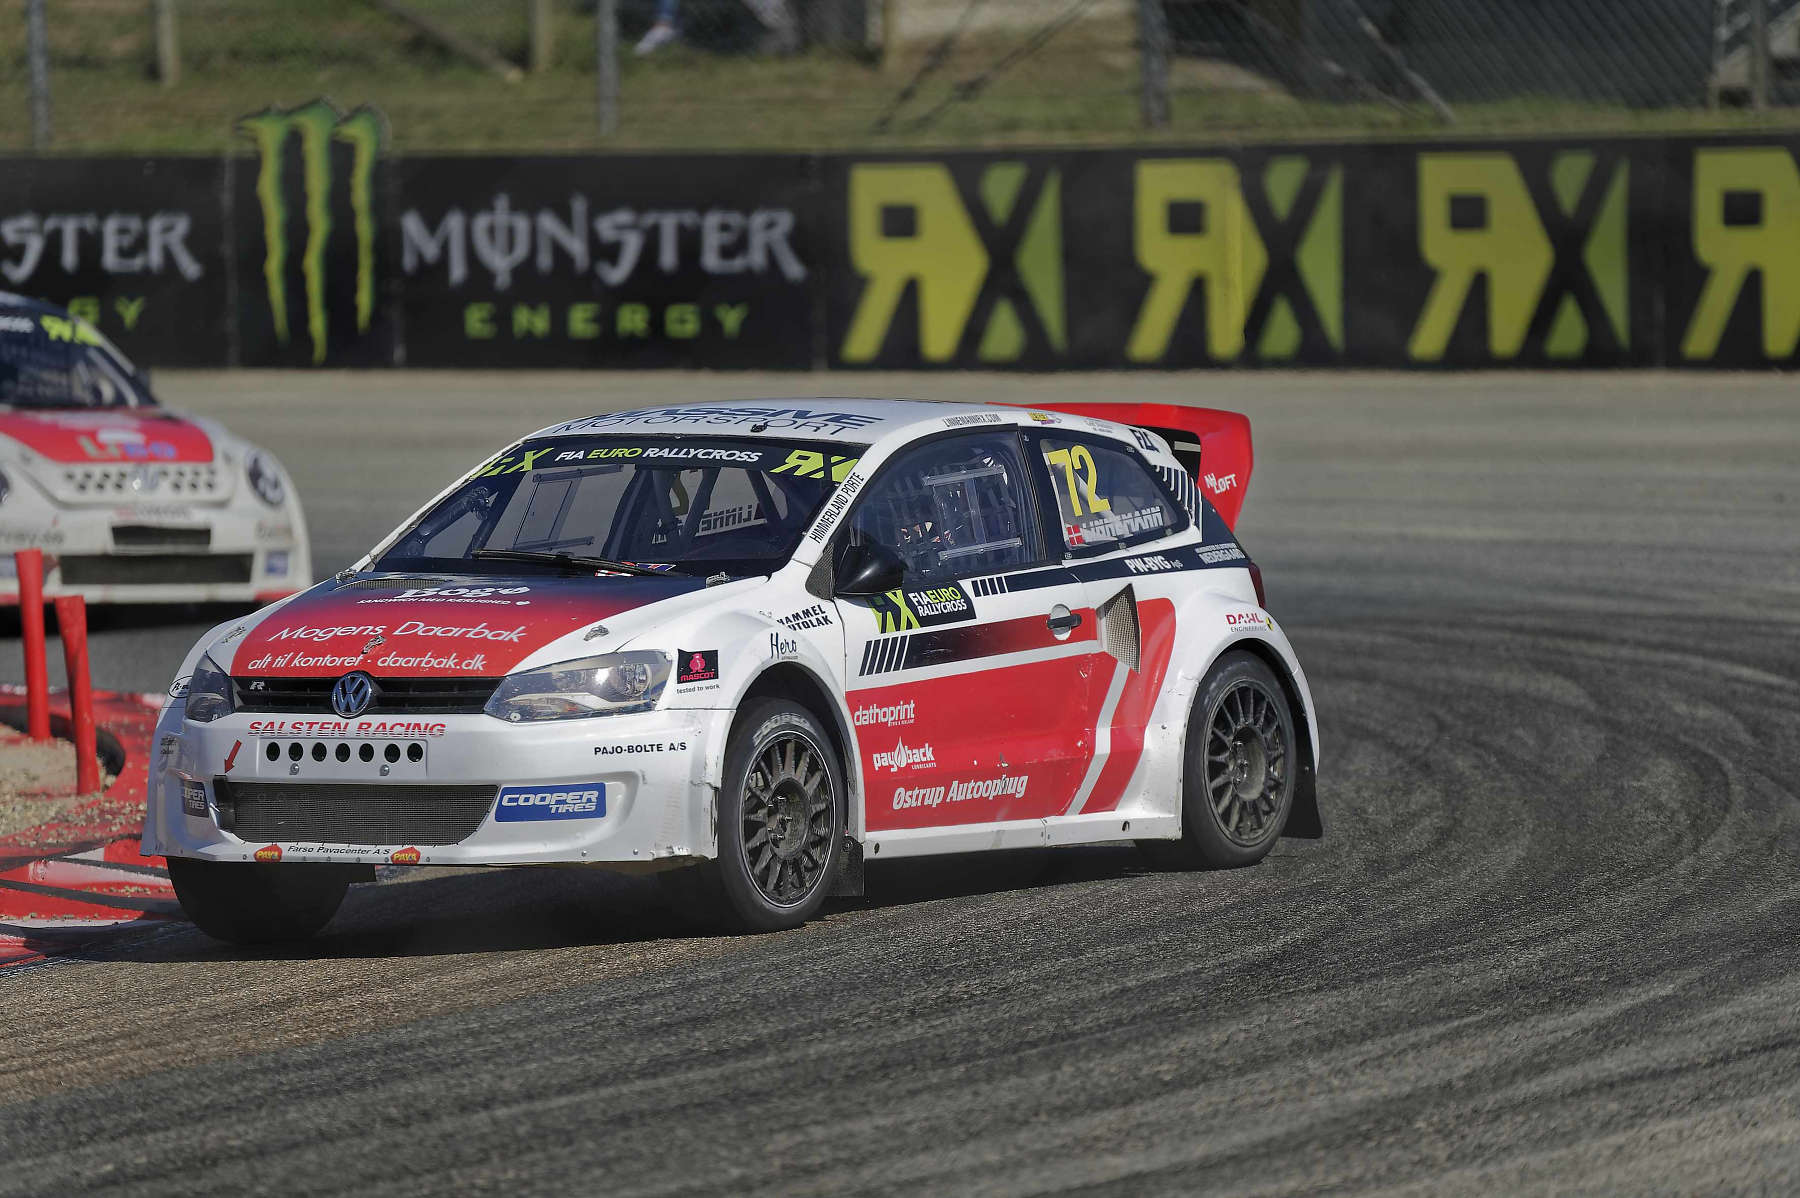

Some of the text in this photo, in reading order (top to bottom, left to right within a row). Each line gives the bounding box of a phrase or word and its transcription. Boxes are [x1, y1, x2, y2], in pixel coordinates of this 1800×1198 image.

[402, 194, 806, 289] MONSTER
[465, 303, 749, 340] ENERGY
[555, 448, 763, 463] FIA EURO RALLYCROSS
[1047, 444, 1111, 517] 72
[809, 471, 866, 544] HIMMERLAND PORTE
[917, 598, 968, 617] RALLYCROSS
[1225, 612, 1264, 625] DAHL
[267, 620, 529, 643] Mogens Daarbak
[248, 653, 271, 670] alt
[273, 652, 289, 669] til
[290, 651, 363, 669] kontoret
[377, 652, 488, 671] daarbak.dk
[680, 671, 716, 682] MASCOT
[853, 699, 916, 728] dathoprint
[247, 721, 447, 738] SALSTEN RACING
[594, 741, 688, 756] PAJO-BOLTE A/S
[500, 790, 600, 808] COOPER
[892, 783, 945, 811] Østrup
[548, 802, 597, 815] TIRES
